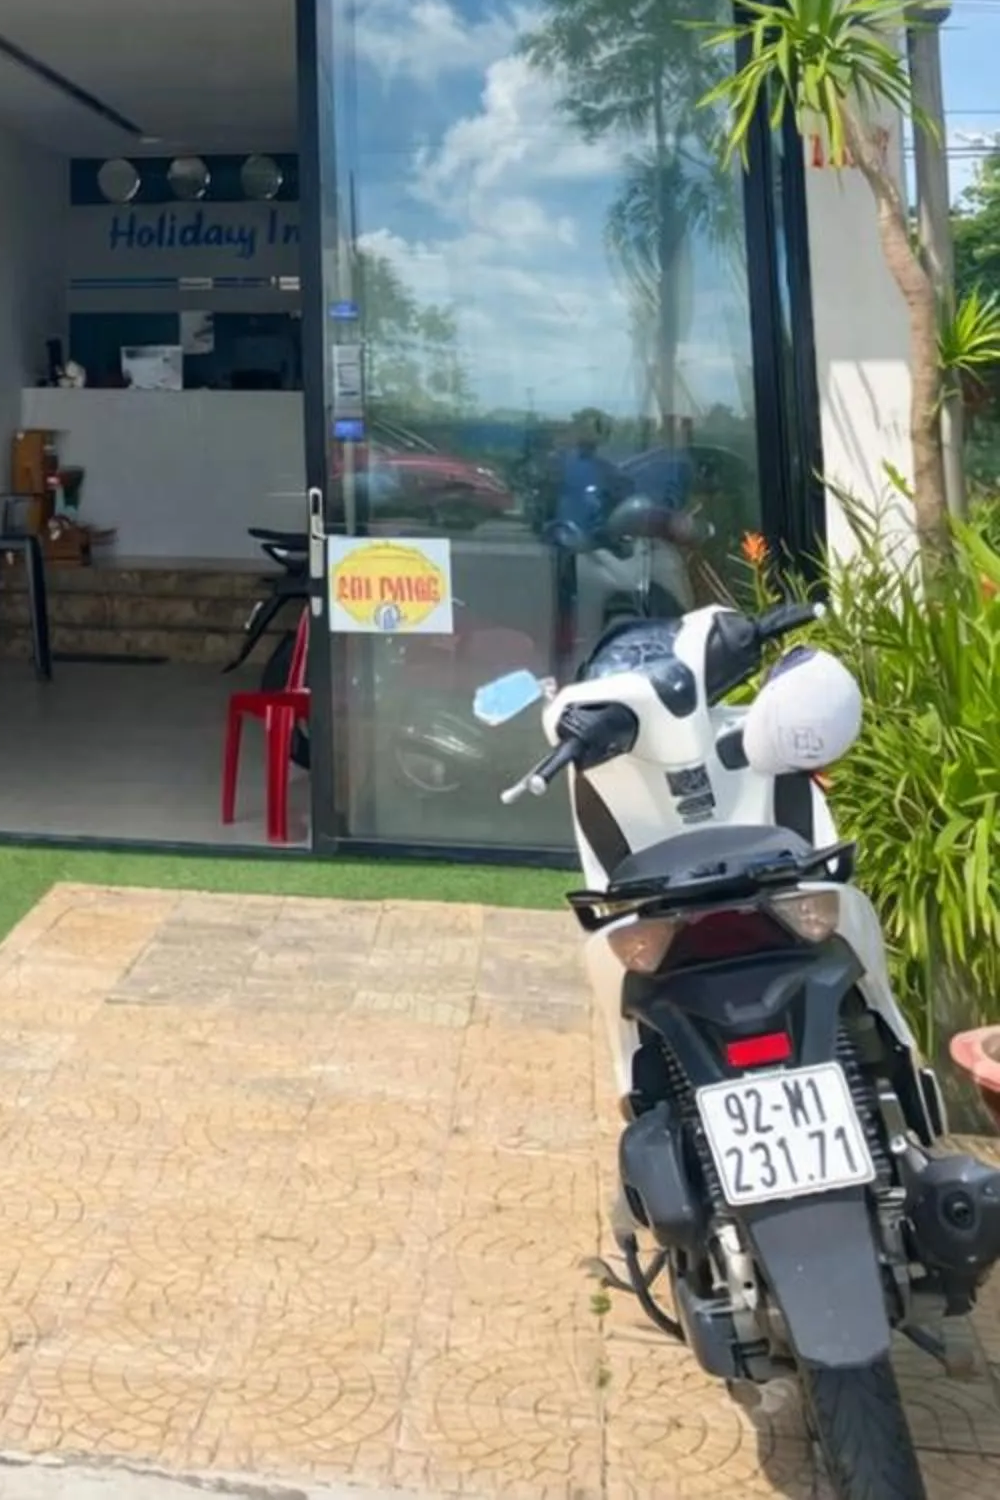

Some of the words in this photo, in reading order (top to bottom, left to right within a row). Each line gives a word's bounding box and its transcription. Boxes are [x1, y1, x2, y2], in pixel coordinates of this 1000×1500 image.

[109, 211, 256, 258] Holiday
[268, 208, 299, 244] In
[725, 1125, 858, 1193] 231.71
